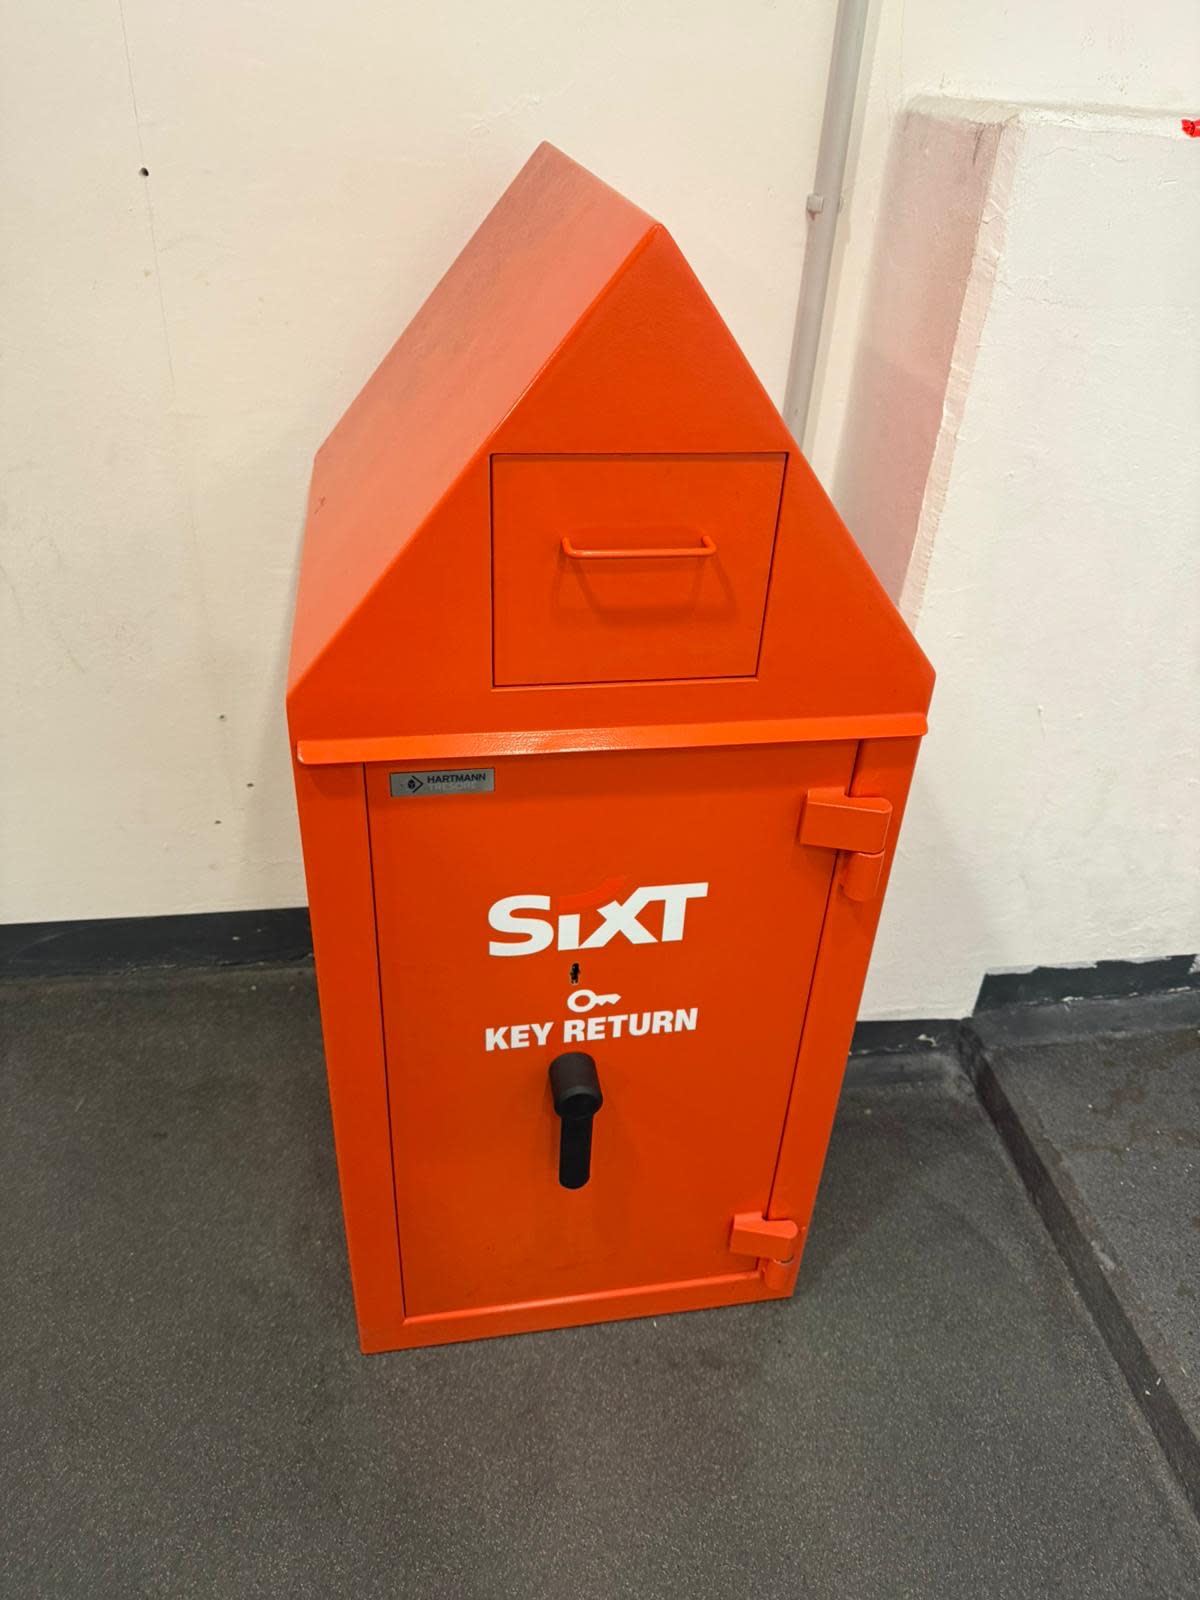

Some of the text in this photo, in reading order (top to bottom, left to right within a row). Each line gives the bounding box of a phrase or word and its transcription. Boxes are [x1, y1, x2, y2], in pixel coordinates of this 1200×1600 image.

[427, 773, 486, 783] HARTMANN
[485, 1008, 698, 1051] KEY RETURN
